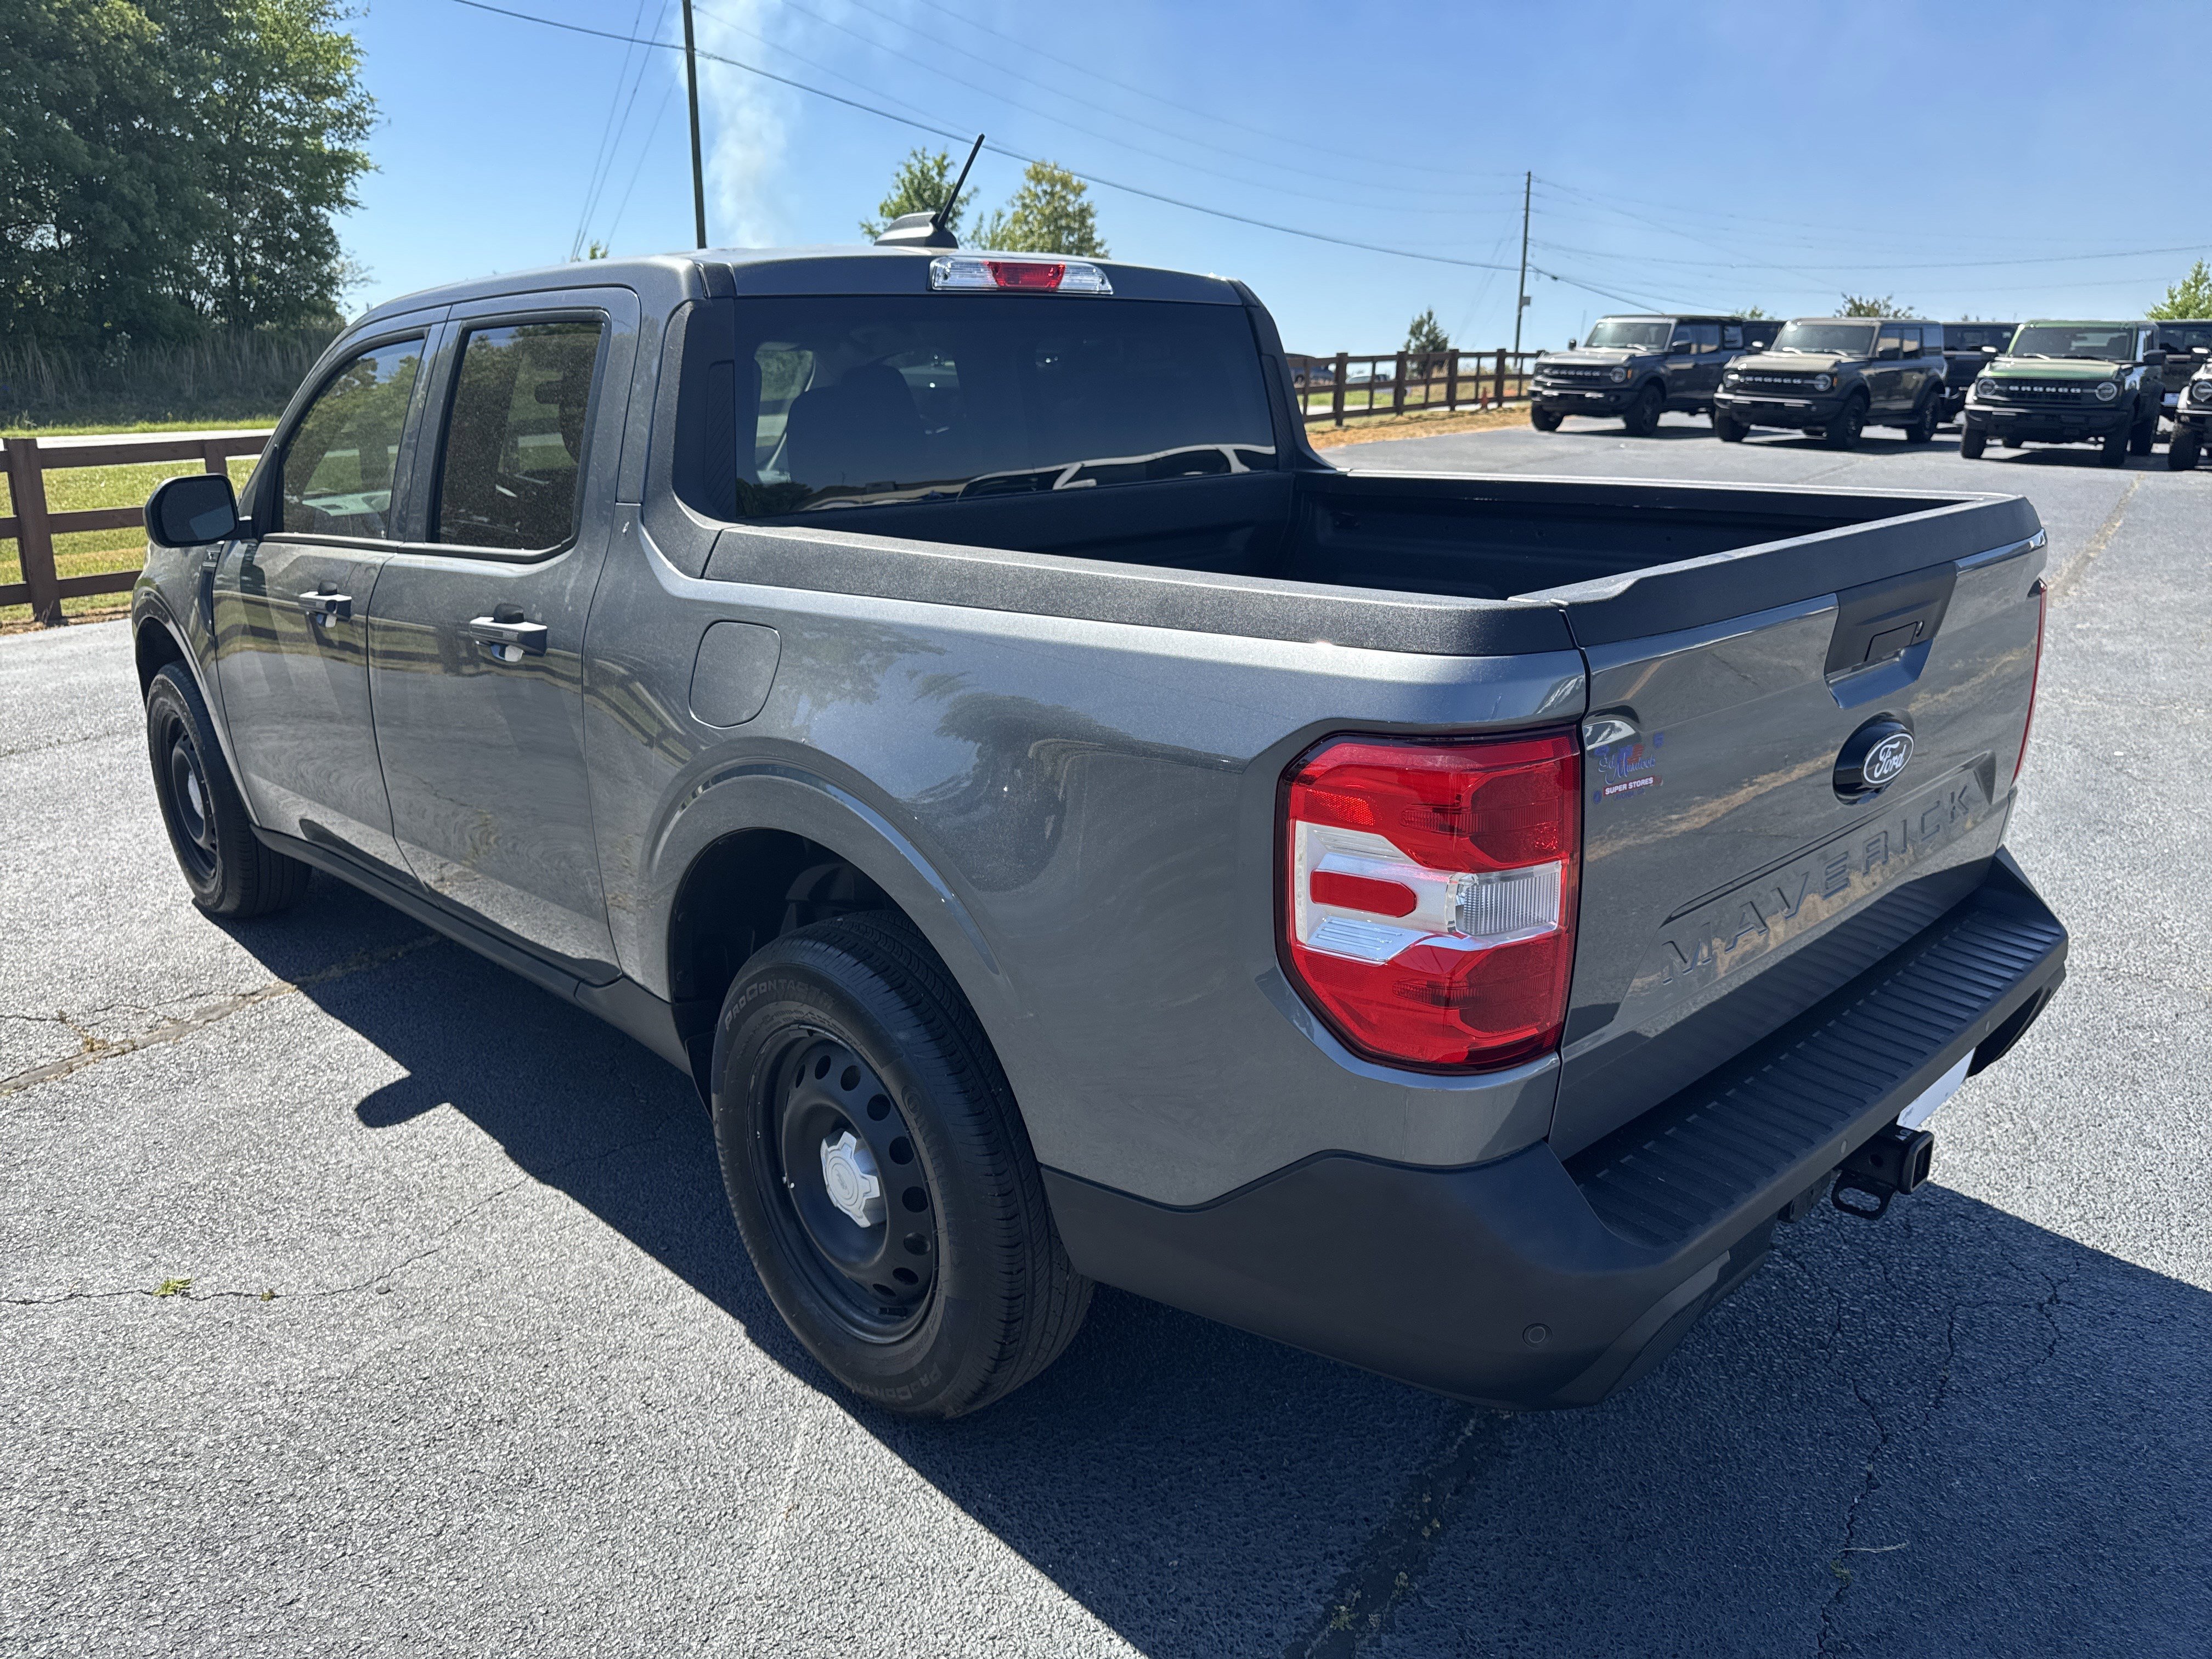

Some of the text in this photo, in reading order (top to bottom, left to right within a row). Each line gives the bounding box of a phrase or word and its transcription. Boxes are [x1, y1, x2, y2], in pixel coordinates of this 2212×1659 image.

[2008, 385, 2081, 393] BRONCO
[1874, 741, 1907, 778] Ford
[1605, 777, 1654, 795] SUPER STORES
[1660, 784, 1971, 985] MAVERICK
